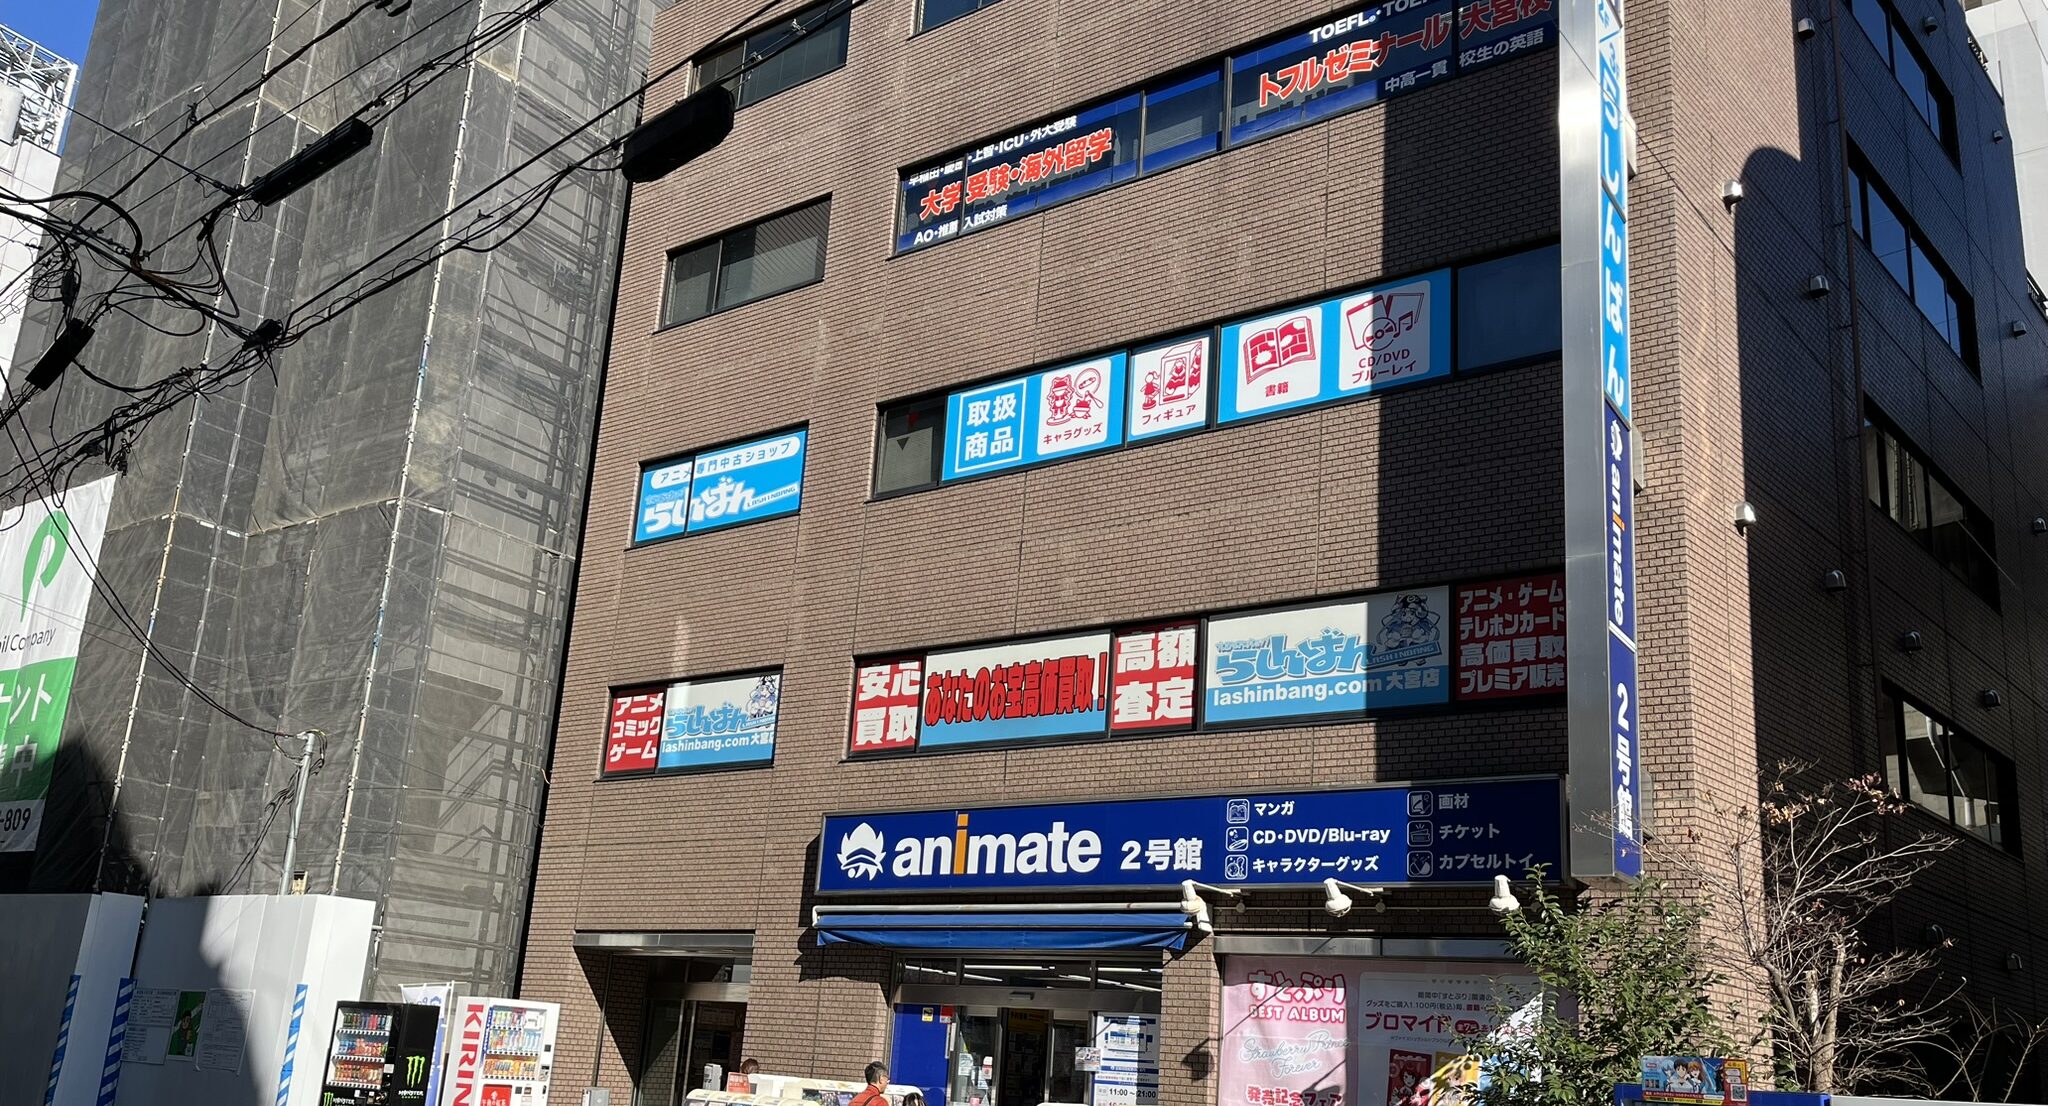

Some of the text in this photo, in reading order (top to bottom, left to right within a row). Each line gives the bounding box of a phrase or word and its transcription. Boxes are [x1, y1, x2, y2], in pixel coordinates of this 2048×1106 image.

[1259, 13, 1451, 107] トフルゼミナール
[1358, 349, 1410, 368] CD/DVD
[1352, 360, 1417, 384] ブルーレイ
[1265, 381, 1289, 397] 書籍
[967, 392, 1017, 427] 取扱
[1142, 404, 1196, 426] フィギュア
[964, 426, 1014, 461] 商品
[1043, 422, 1103, 445] キャラグッズ
[1609, 463, 1626, 627] animate
[1460, 580, 1565, 613] アニメ・ゲーム
[1460, 609, 1565, 640] テレホンカード
[1117, 628, 1196, 673] 高額
[1460, 636, 1565, 665] 高価買取
[859, 661, 921, 700] 安心
[1214, 669, 1440, 706] lashinbang.com 大宮店
[1460, 664, 1565, 694] プレミア販売
[615, 693, 664, 716] アニメ
[1114, 677, 1195, 723] 査定
[612, 715, 661, 738] コミック
[855, 705, 918, 746] 買取
[609, 740, 657, 763] ゲーム
[662, 735, 749, 753] lashinbang.com
[1254, 800, 1295, 816] マンガ
[1438, 793, 1469, 809] 画材
[1439, 824, 1500, 840] チケット
[892, 814, 1203, 877] animate 2号館
[1252, 855, 1379, 873] キャラクターグッズ
[1439, 853, 1534, 870] カプセルトイ
[1248, 970, 1347, 1004] すとぷり
[1250, 1005, 1345, 1023] BEST ALBUM
[452, 1004, 484, 1106] KIRIN
[1271, 1057, 1321, 1078] Forever
